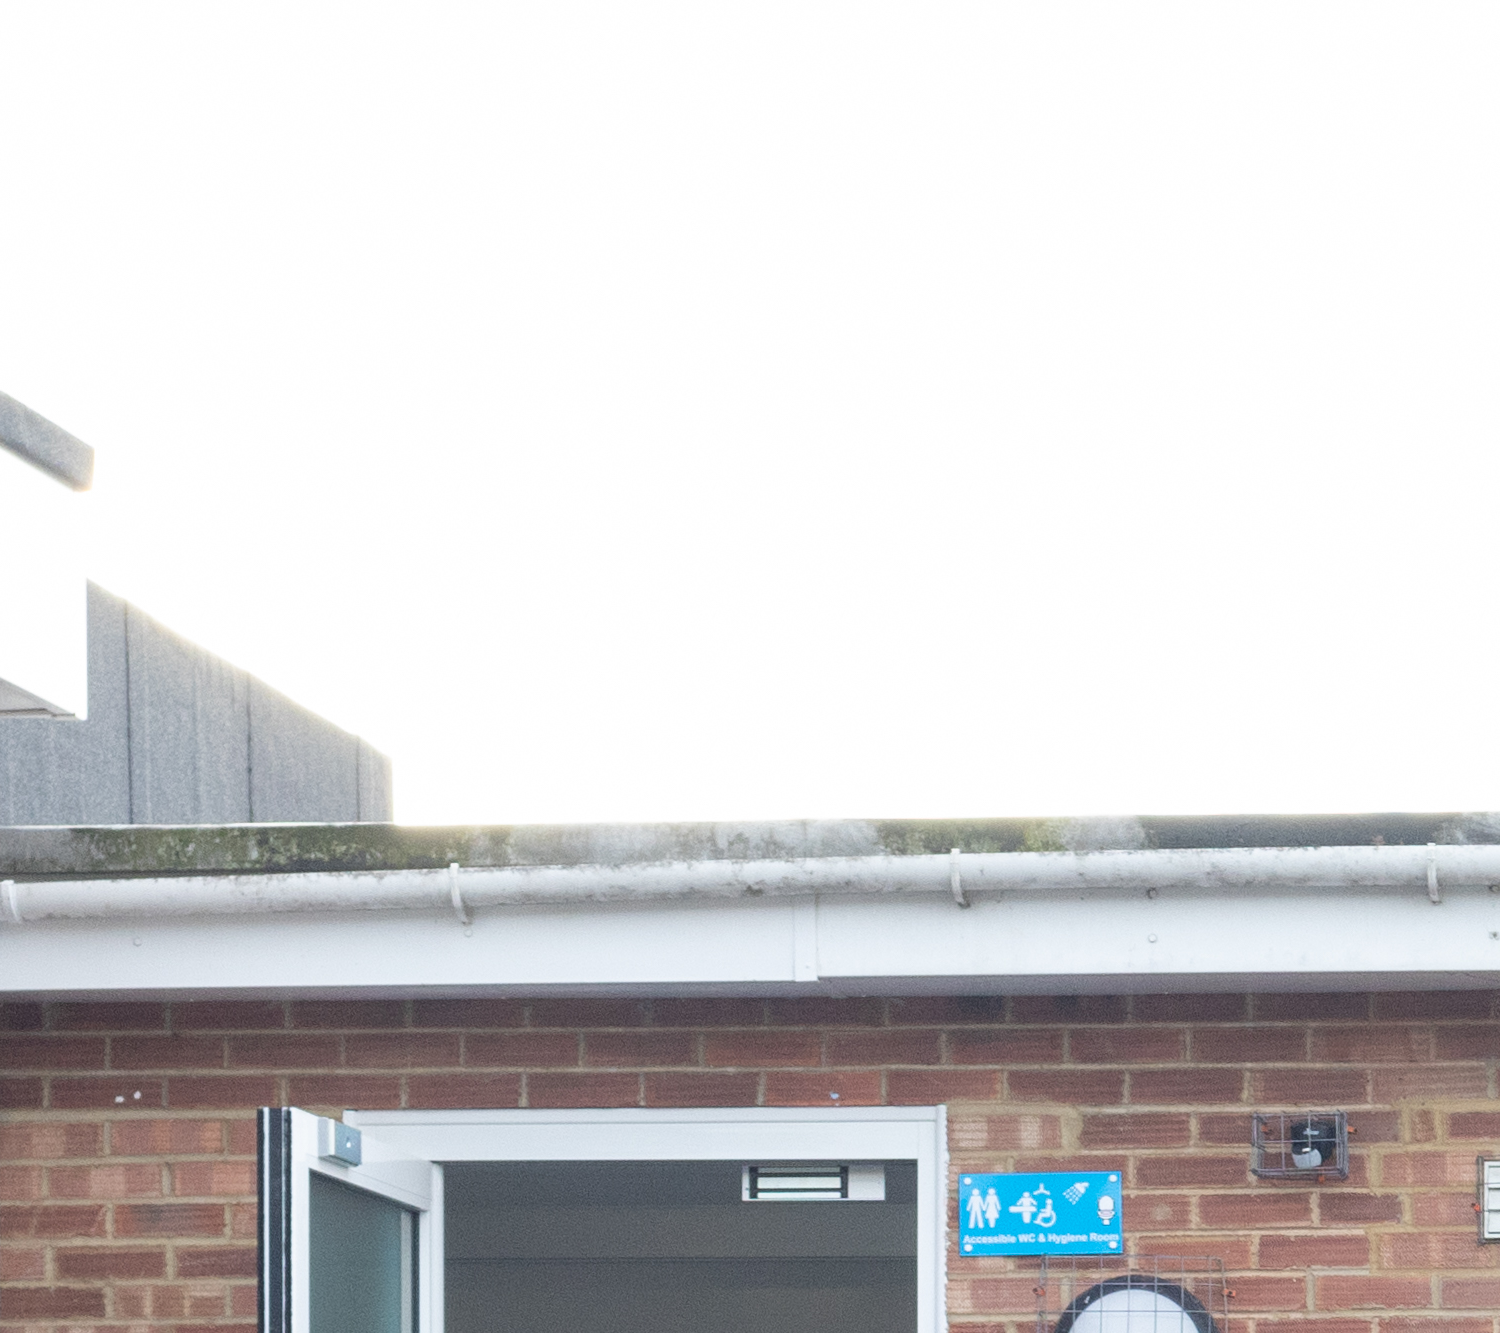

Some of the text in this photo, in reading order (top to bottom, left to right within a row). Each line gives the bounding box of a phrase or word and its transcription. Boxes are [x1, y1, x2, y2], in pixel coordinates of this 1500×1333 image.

[964, 1233, 1119, 1244] Accessible WC & Hygiene Room
